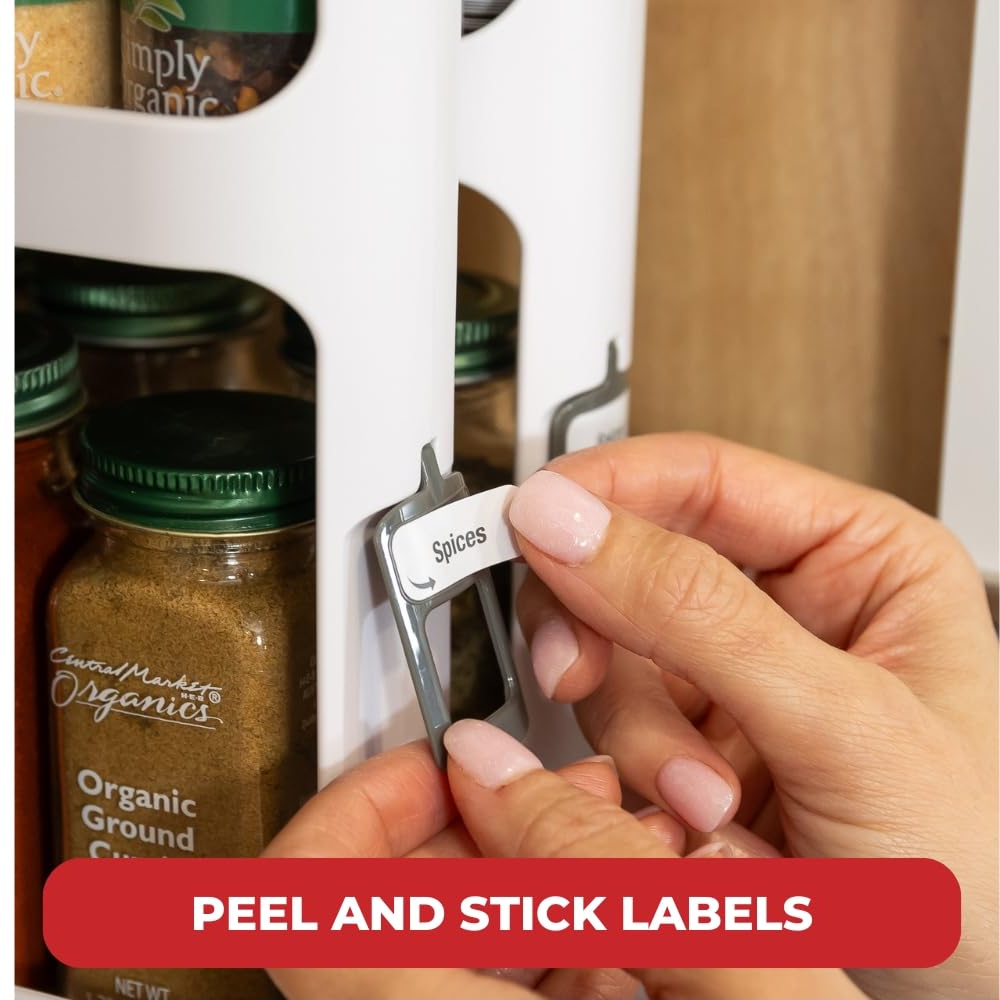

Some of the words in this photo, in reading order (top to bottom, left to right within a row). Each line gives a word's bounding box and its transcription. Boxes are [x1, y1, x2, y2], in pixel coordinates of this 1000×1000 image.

[432, 526, 487, 564] Spices
[50, 647, 128, 676] Central
[51, 670, 223, 724] Organics
[77, 768, 197, 818] Organic
[81, 804, 195, 852] Ground
[115, 976, 143, 1000] NET
